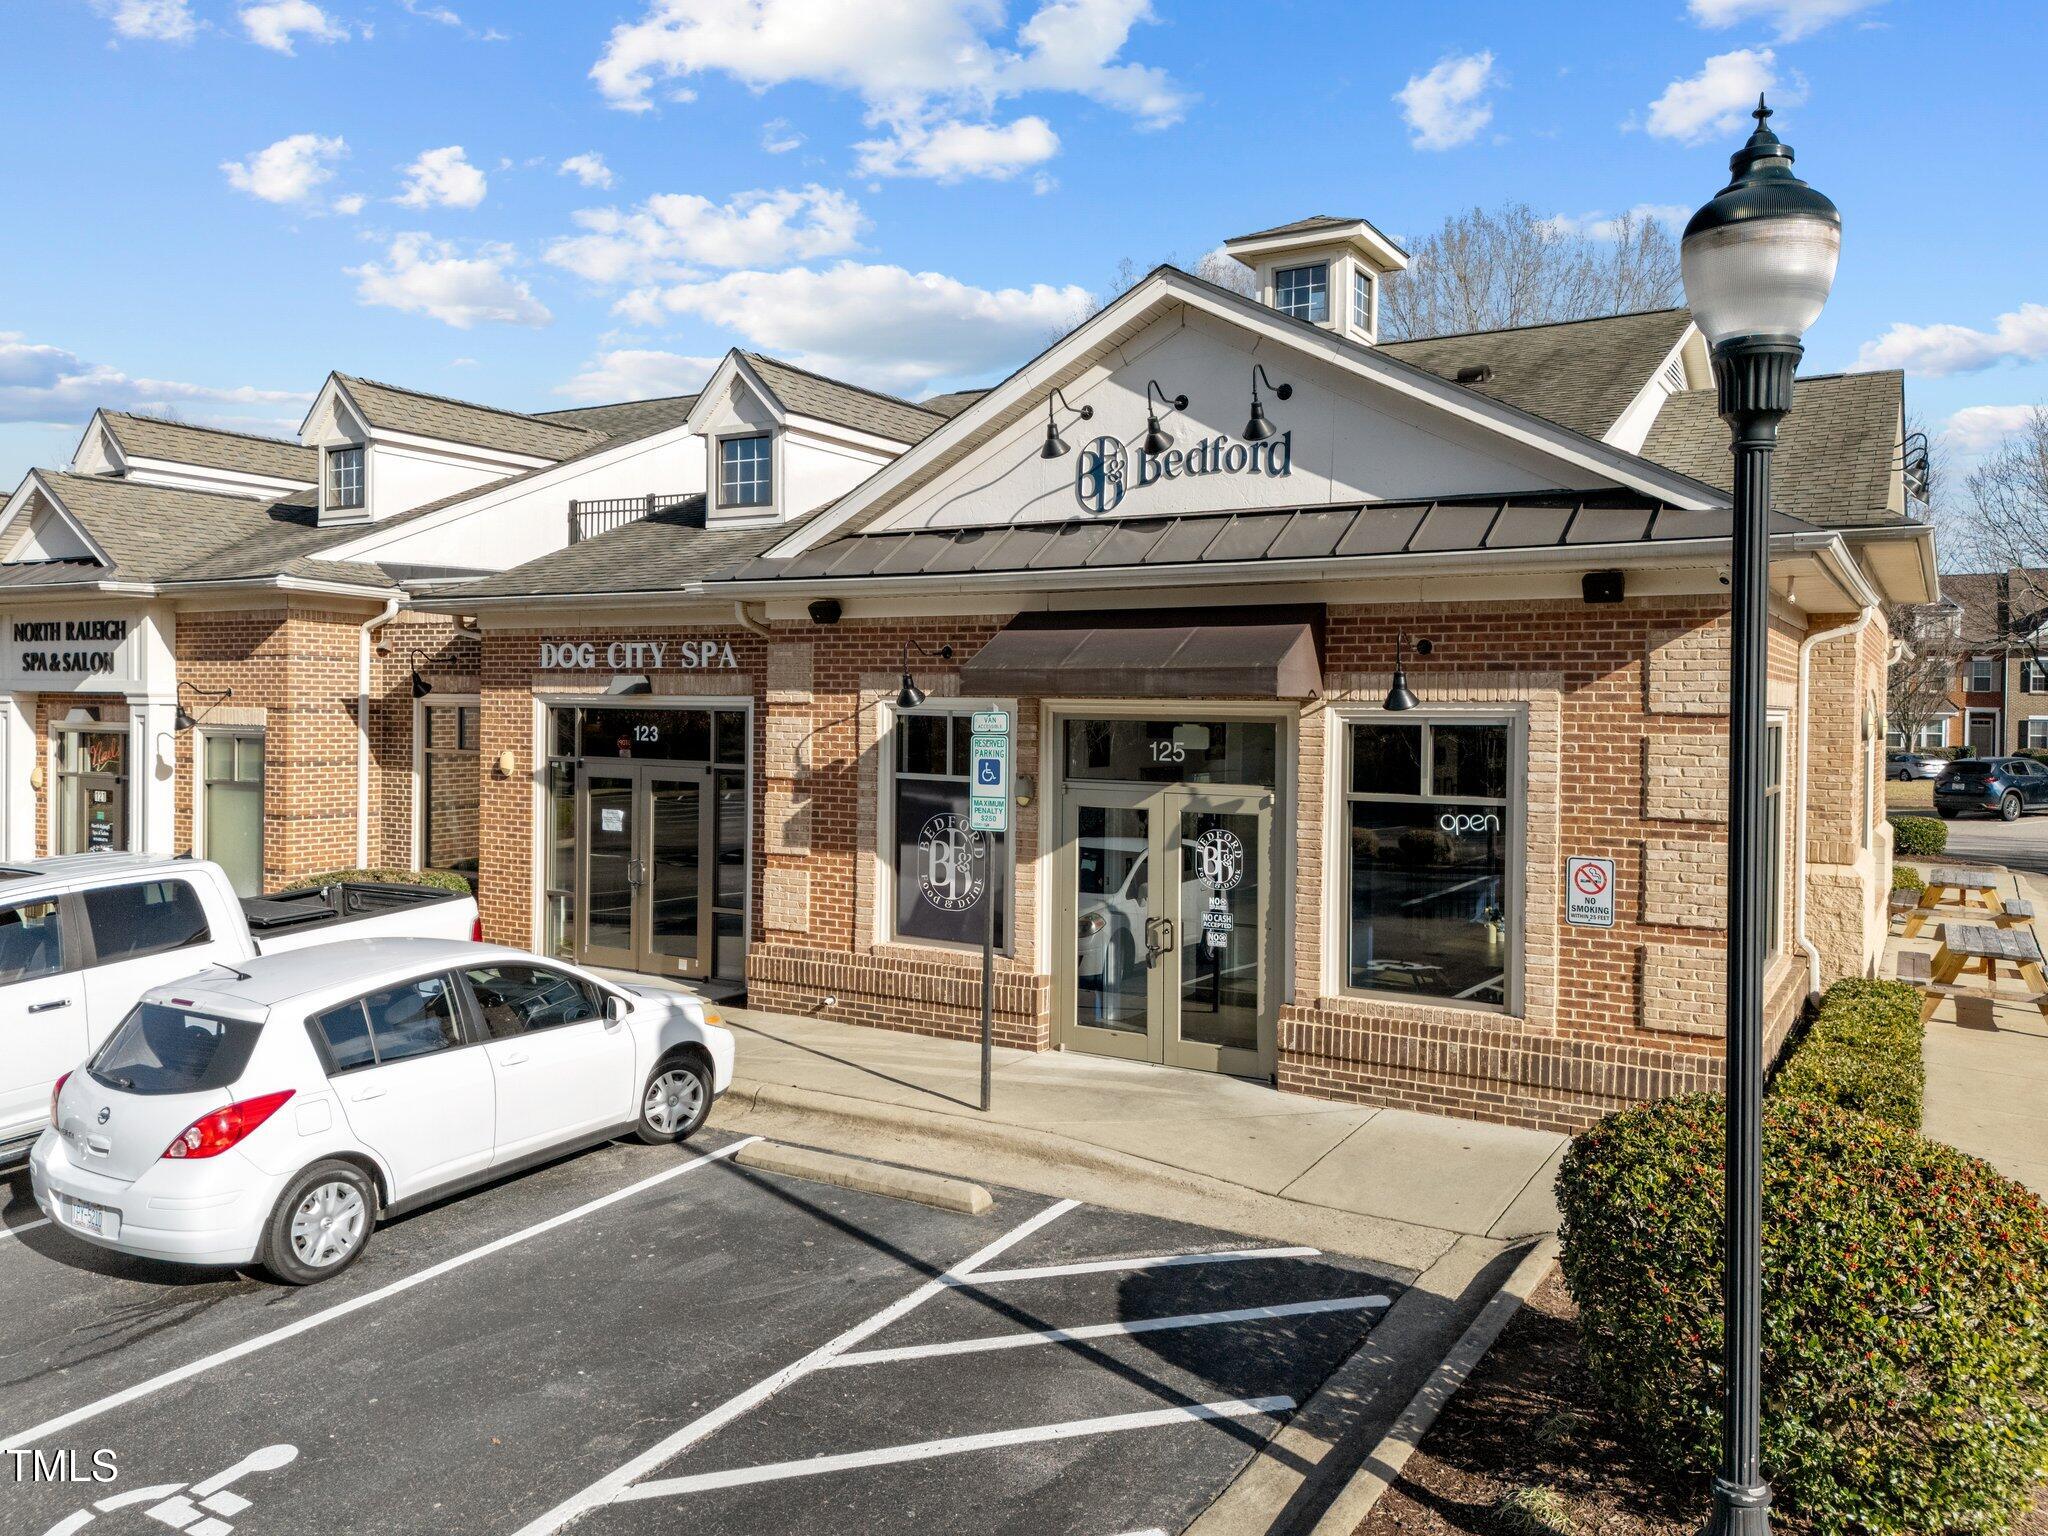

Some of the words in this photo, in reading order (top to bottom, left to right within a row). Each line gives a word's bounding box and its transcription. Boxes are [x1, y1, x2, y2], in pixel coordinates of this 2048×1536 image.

[1137, 431, 1292, 488] Bedford
[14, 622, 61, 641] NORTH
[65, 620, 127, 640] RALEIGH
[540, 642, 596, 669] DOG
[607, 641, 668, 669] CITY
[681, 641, 738, 669] SPA
[634, 725, 659, 742] 123
[974, 738, 1005, 748] RESERVED
[974, 749, 1005, 758] PARKING
[1150, 741, 1186, 763] 125
[973, 799, 1005, 808] MAXIMUM
[974, 807, 1004, 815] PENALTY
[1440, 814, 1500, 836] open
[919, 815, 985, 859] BEDFORD
[1197, 831, 1242, 858] BEDFORD
[921, 874, 940, 904] Food
[957, 878, 983, 909] Drink
[1208, 897, 1220, 906] NO
[1571, 905, 1609, 914] SMOKING
[1202, 913, 1213, 922] NO
[1213, 914, 1231, 923] CASH
[1208, 933, 1219, 942] NO
